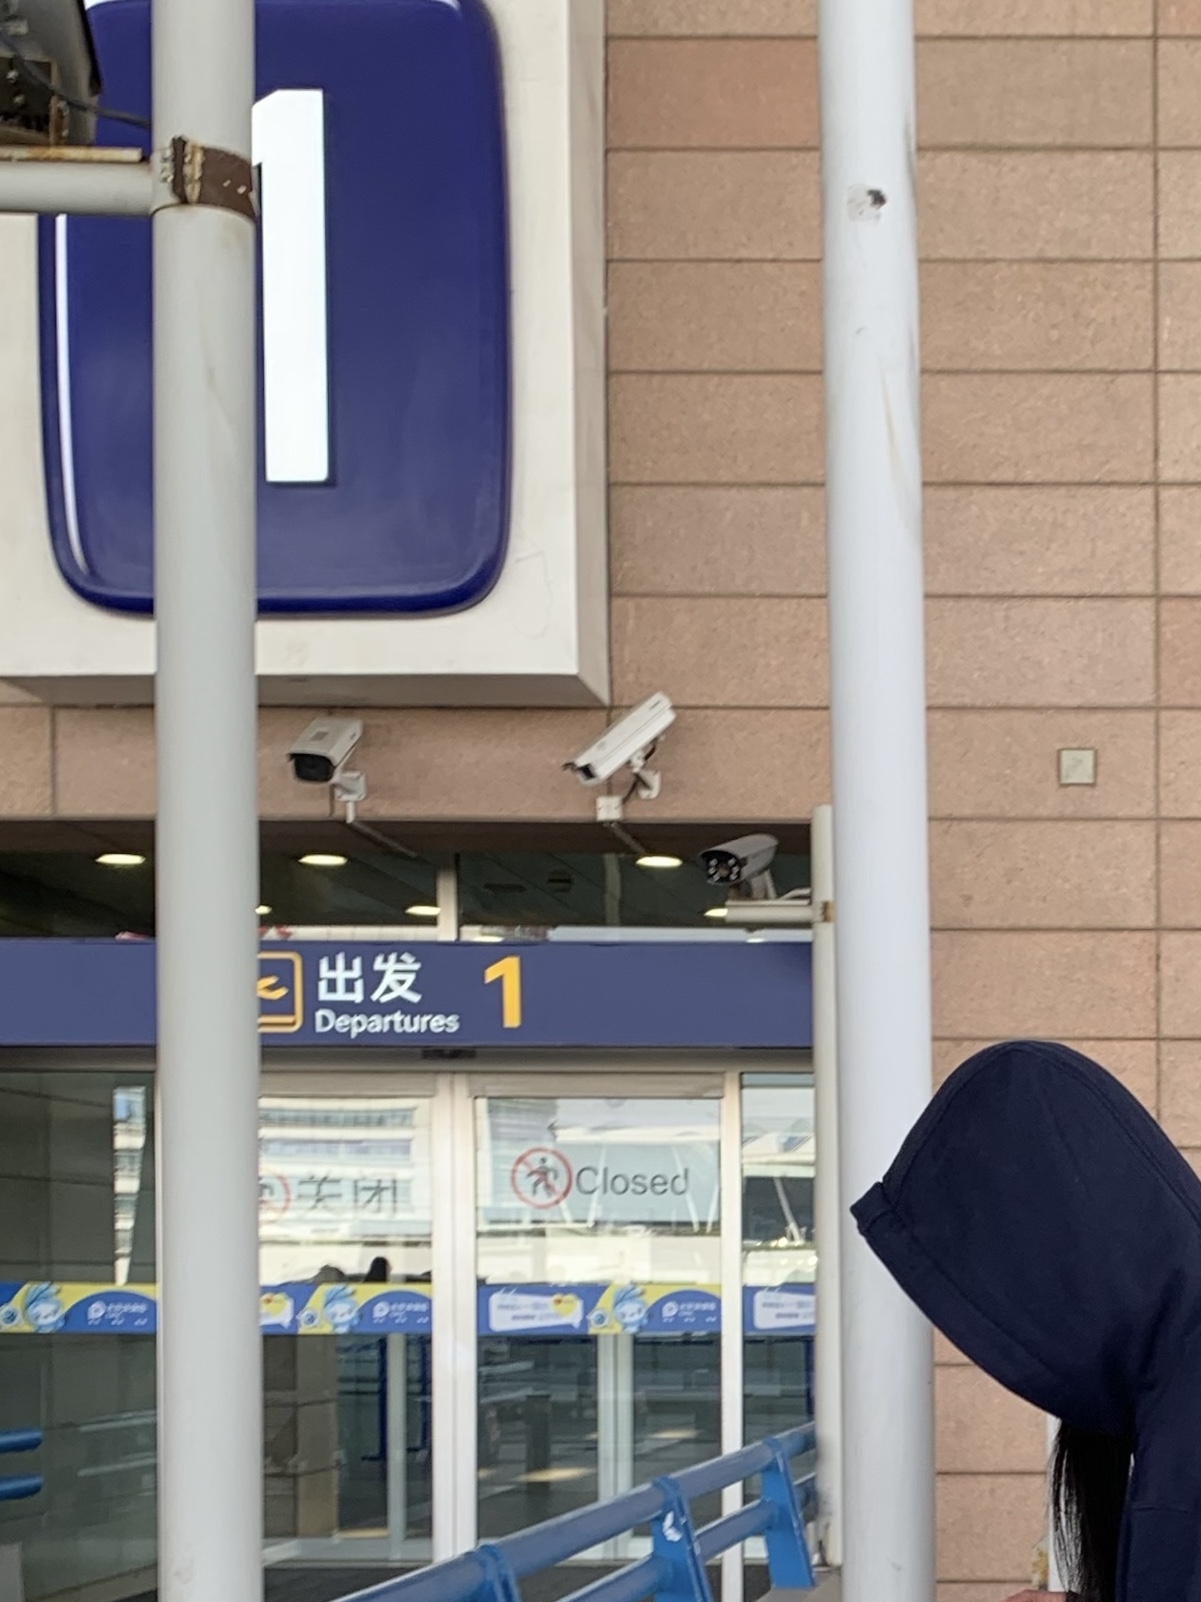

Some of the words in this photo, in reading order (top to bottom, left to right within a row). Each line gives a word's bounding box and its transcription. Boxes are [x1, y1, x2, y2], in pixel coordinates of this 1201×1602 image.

[252, 88, 329, 483] 1
[317, 951, 423, 1004] 出发
[484, 955, 523, 1029] 1
[314, 1008, 460, 1039] Departures
[296, 1174, 399, 1215] 关闭
[575, 1166, 690, 1197] Closed
